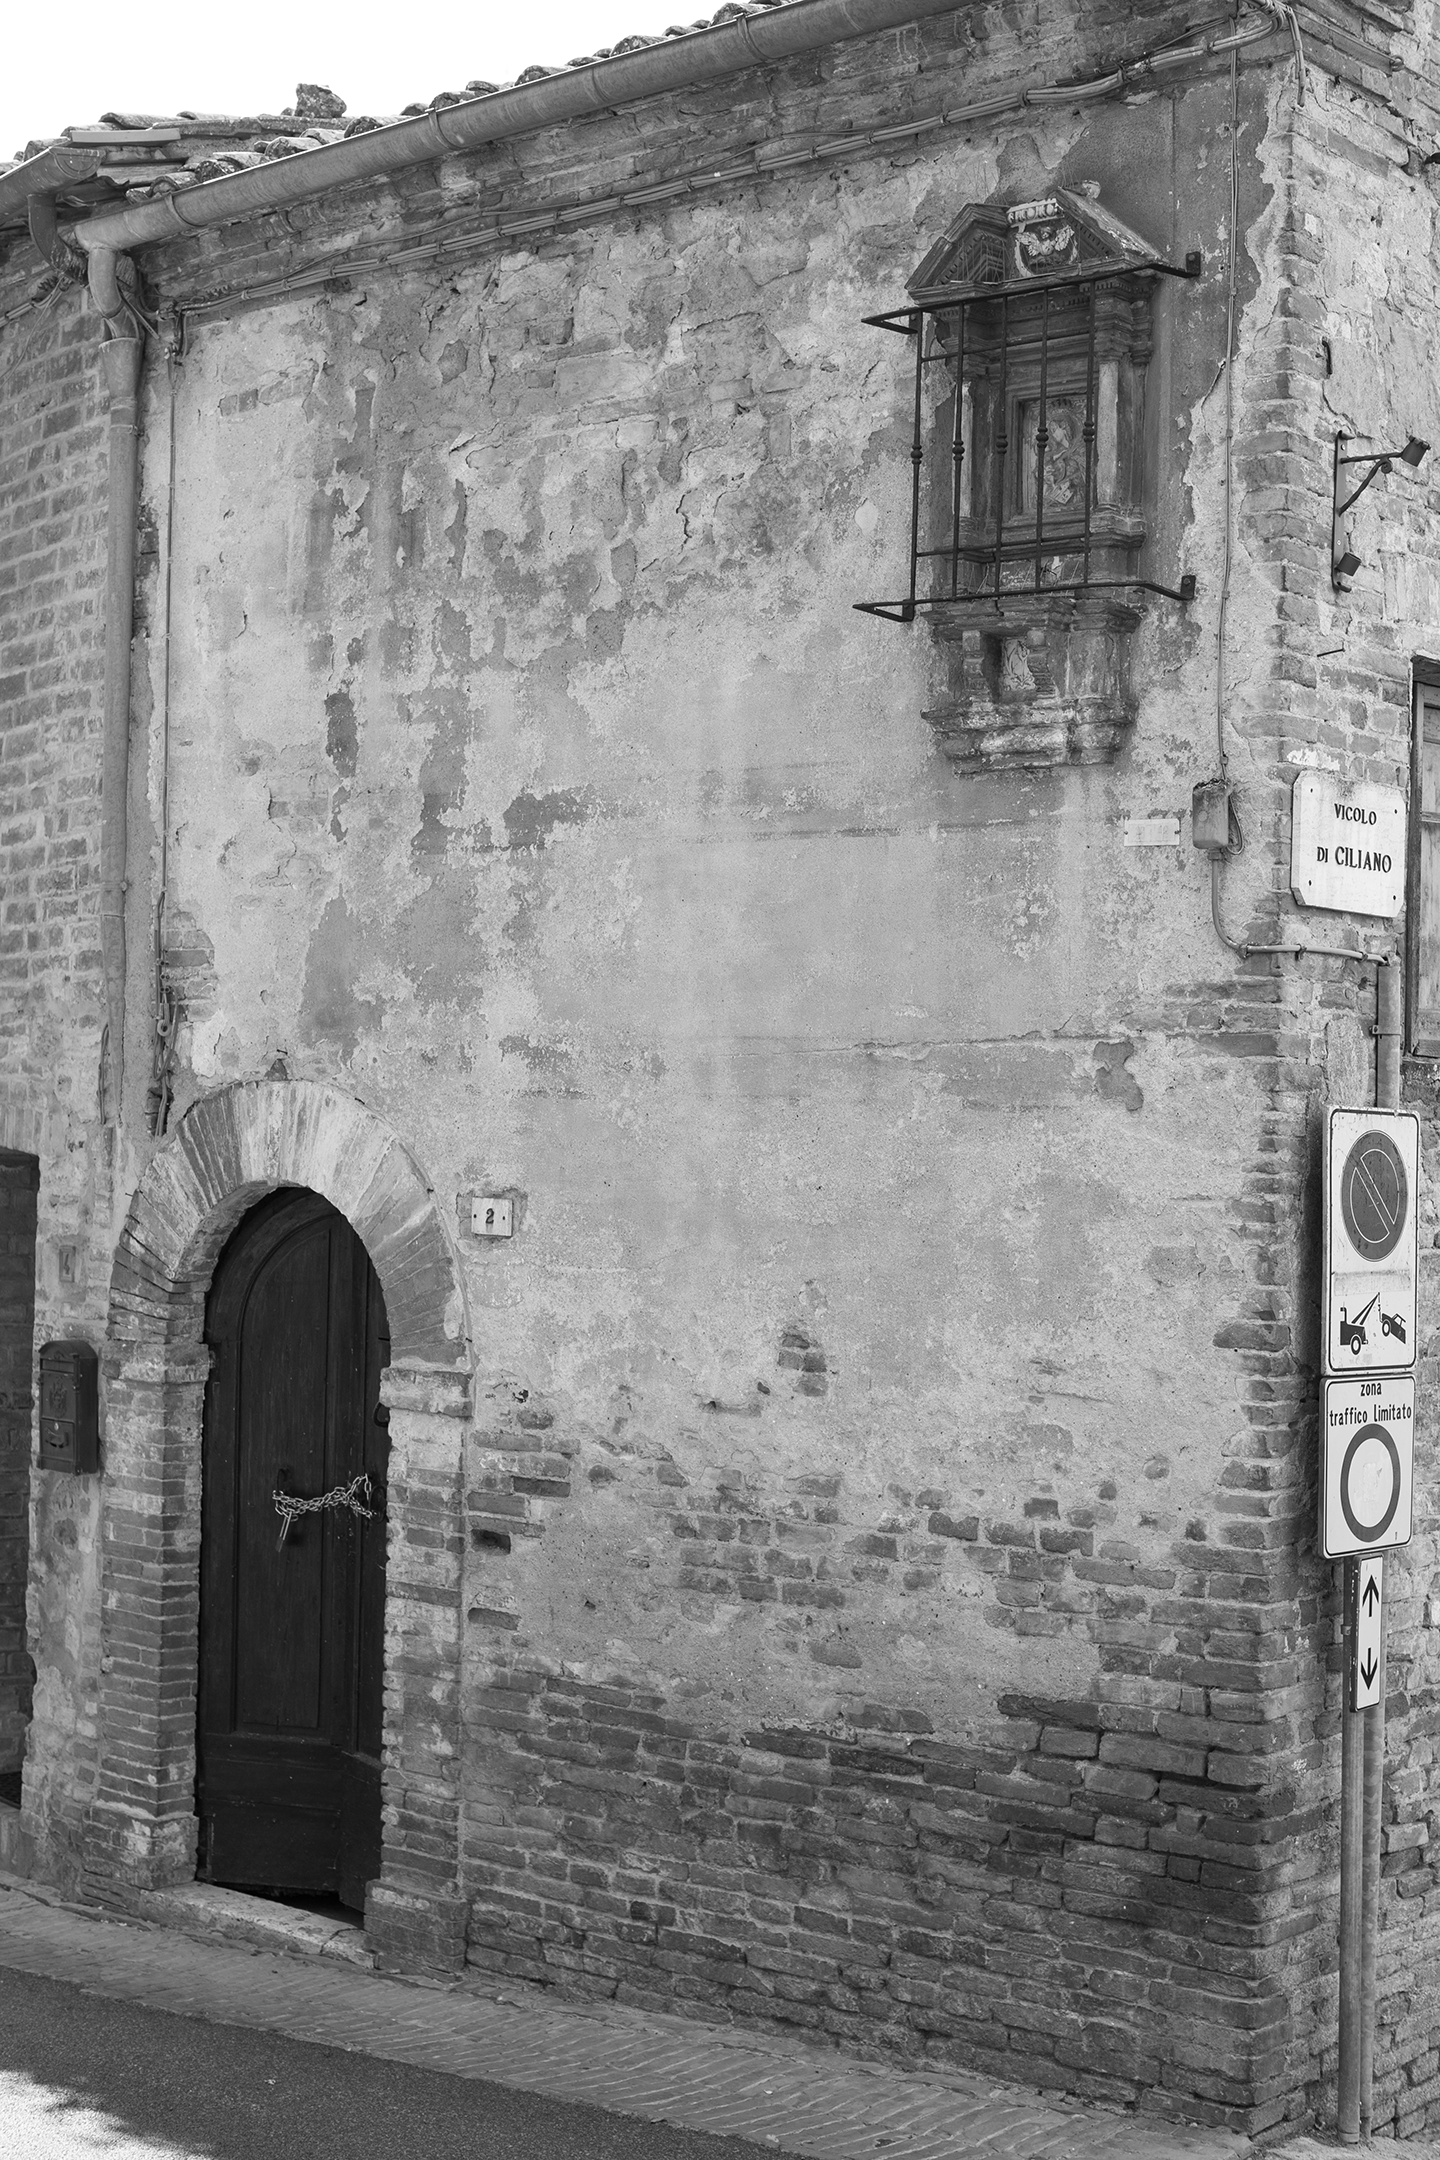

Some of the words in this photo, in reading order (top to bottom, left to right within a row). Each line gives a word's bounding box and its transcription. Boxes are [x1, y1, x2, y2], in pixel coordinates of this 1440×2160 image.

[1334, 803, 1377, 825] VICOLO
[1317, 846, 1329, 863] DI
[1335, 846, 1392, 873] CILIANO
[485, 1208, 494, 1224] 2
[1360, 1382, 1382, 1397] zona
[1329, 1407, 1368, 1426] traffico
[1373, 1403, 1412, 1422] limitato
